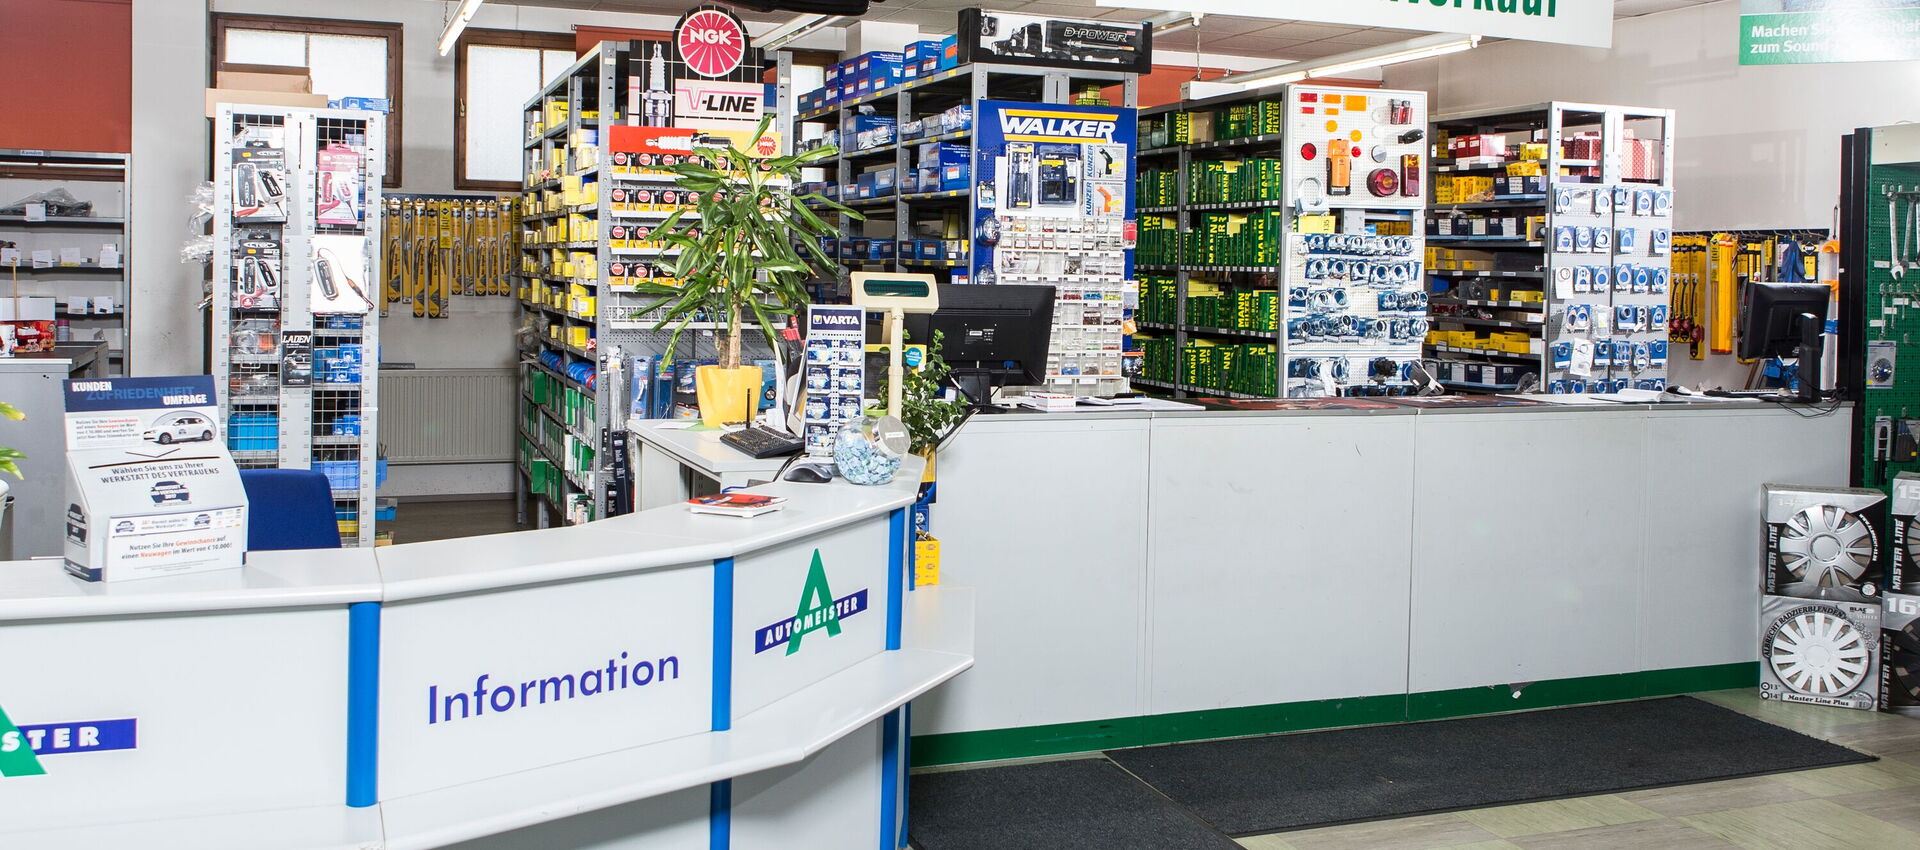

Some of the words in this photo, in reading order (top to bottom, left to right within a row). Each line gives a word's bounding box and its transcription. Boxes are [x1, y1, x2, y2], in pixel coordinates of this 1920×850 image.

[689, 28, 732, 46] NGK
[1063, 26, 1127, 43] D-POWER
[1751, 24, 1807, 38] Machen
[1750, 42, 1780, 54] zum
[687, 87, 757, 113] V-LINE
[998, 109, 1116, 143] WALKER
[1085, 181, 1093, 216] KUNZER
[822, 316, 859, 325] VARTA
[1269, 296, 1277, 330] MANN
[282, 335, 311, 344] LADEN
[72, 381, 112, 392] KUNDEN
[87, 386, 194, 401] ZUFRIEDENHEIT
[162, 394, 208, 405] UMFRAGE
[101, 473, 150, 484] WERKSTATT
[168, 468, 219, 478] VERTRAUENS
[111, 465, 144, 475] Wählen
[144, 464, 157, 472] Sie
[1768, 524, 1778, 549] LINE
[1894, 519, 1904, 544] LINE
[140, 550, 172, 558] Neuwagen
[1767, 551, 1777, 593] MASTER
[1892, 547, 1903, 590] MASTER
[764, 595, 859, 647] AUTOMEISTER
[1764, 623, 1780, 656] ALBRECHT
[1779, 606, 1846, 625] RADZIERBLENDEN
[1883, 633, 1892, 661] LINE
[429, 652, 679, 724] Information
[1788, 694, 1814, 703] Master
[1881, 664, 1890, 710] MASTER
[1, 726, 101, 752] STER
